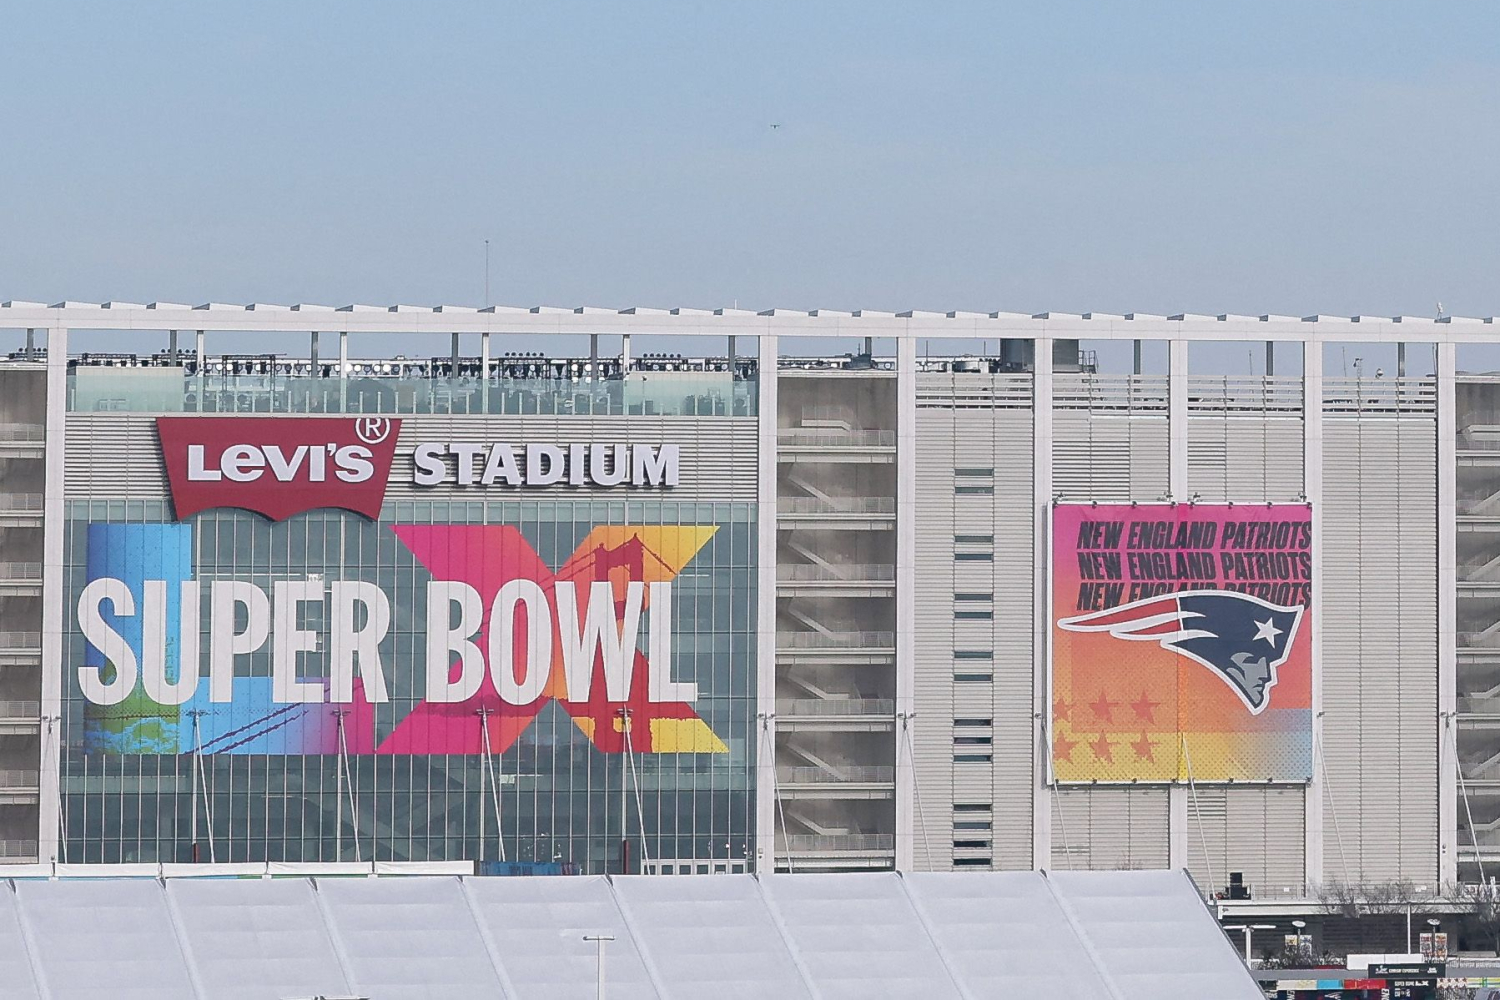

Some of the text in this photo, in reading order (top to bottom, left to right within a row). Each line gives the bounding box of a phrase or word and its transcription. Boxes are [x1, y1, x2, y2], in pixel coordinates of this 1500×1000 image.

[413, 443, 680, 487] STADIUM
[1077, 521, 1312, 549] NEW ENGLAND PATRIOTS
[1077, 552, 1312, 580] NEW ENGLAND PATRIOTS
[1077, 582, 1124, 611] NEW
[77, 578, 699, 706] SUPER BOWL
